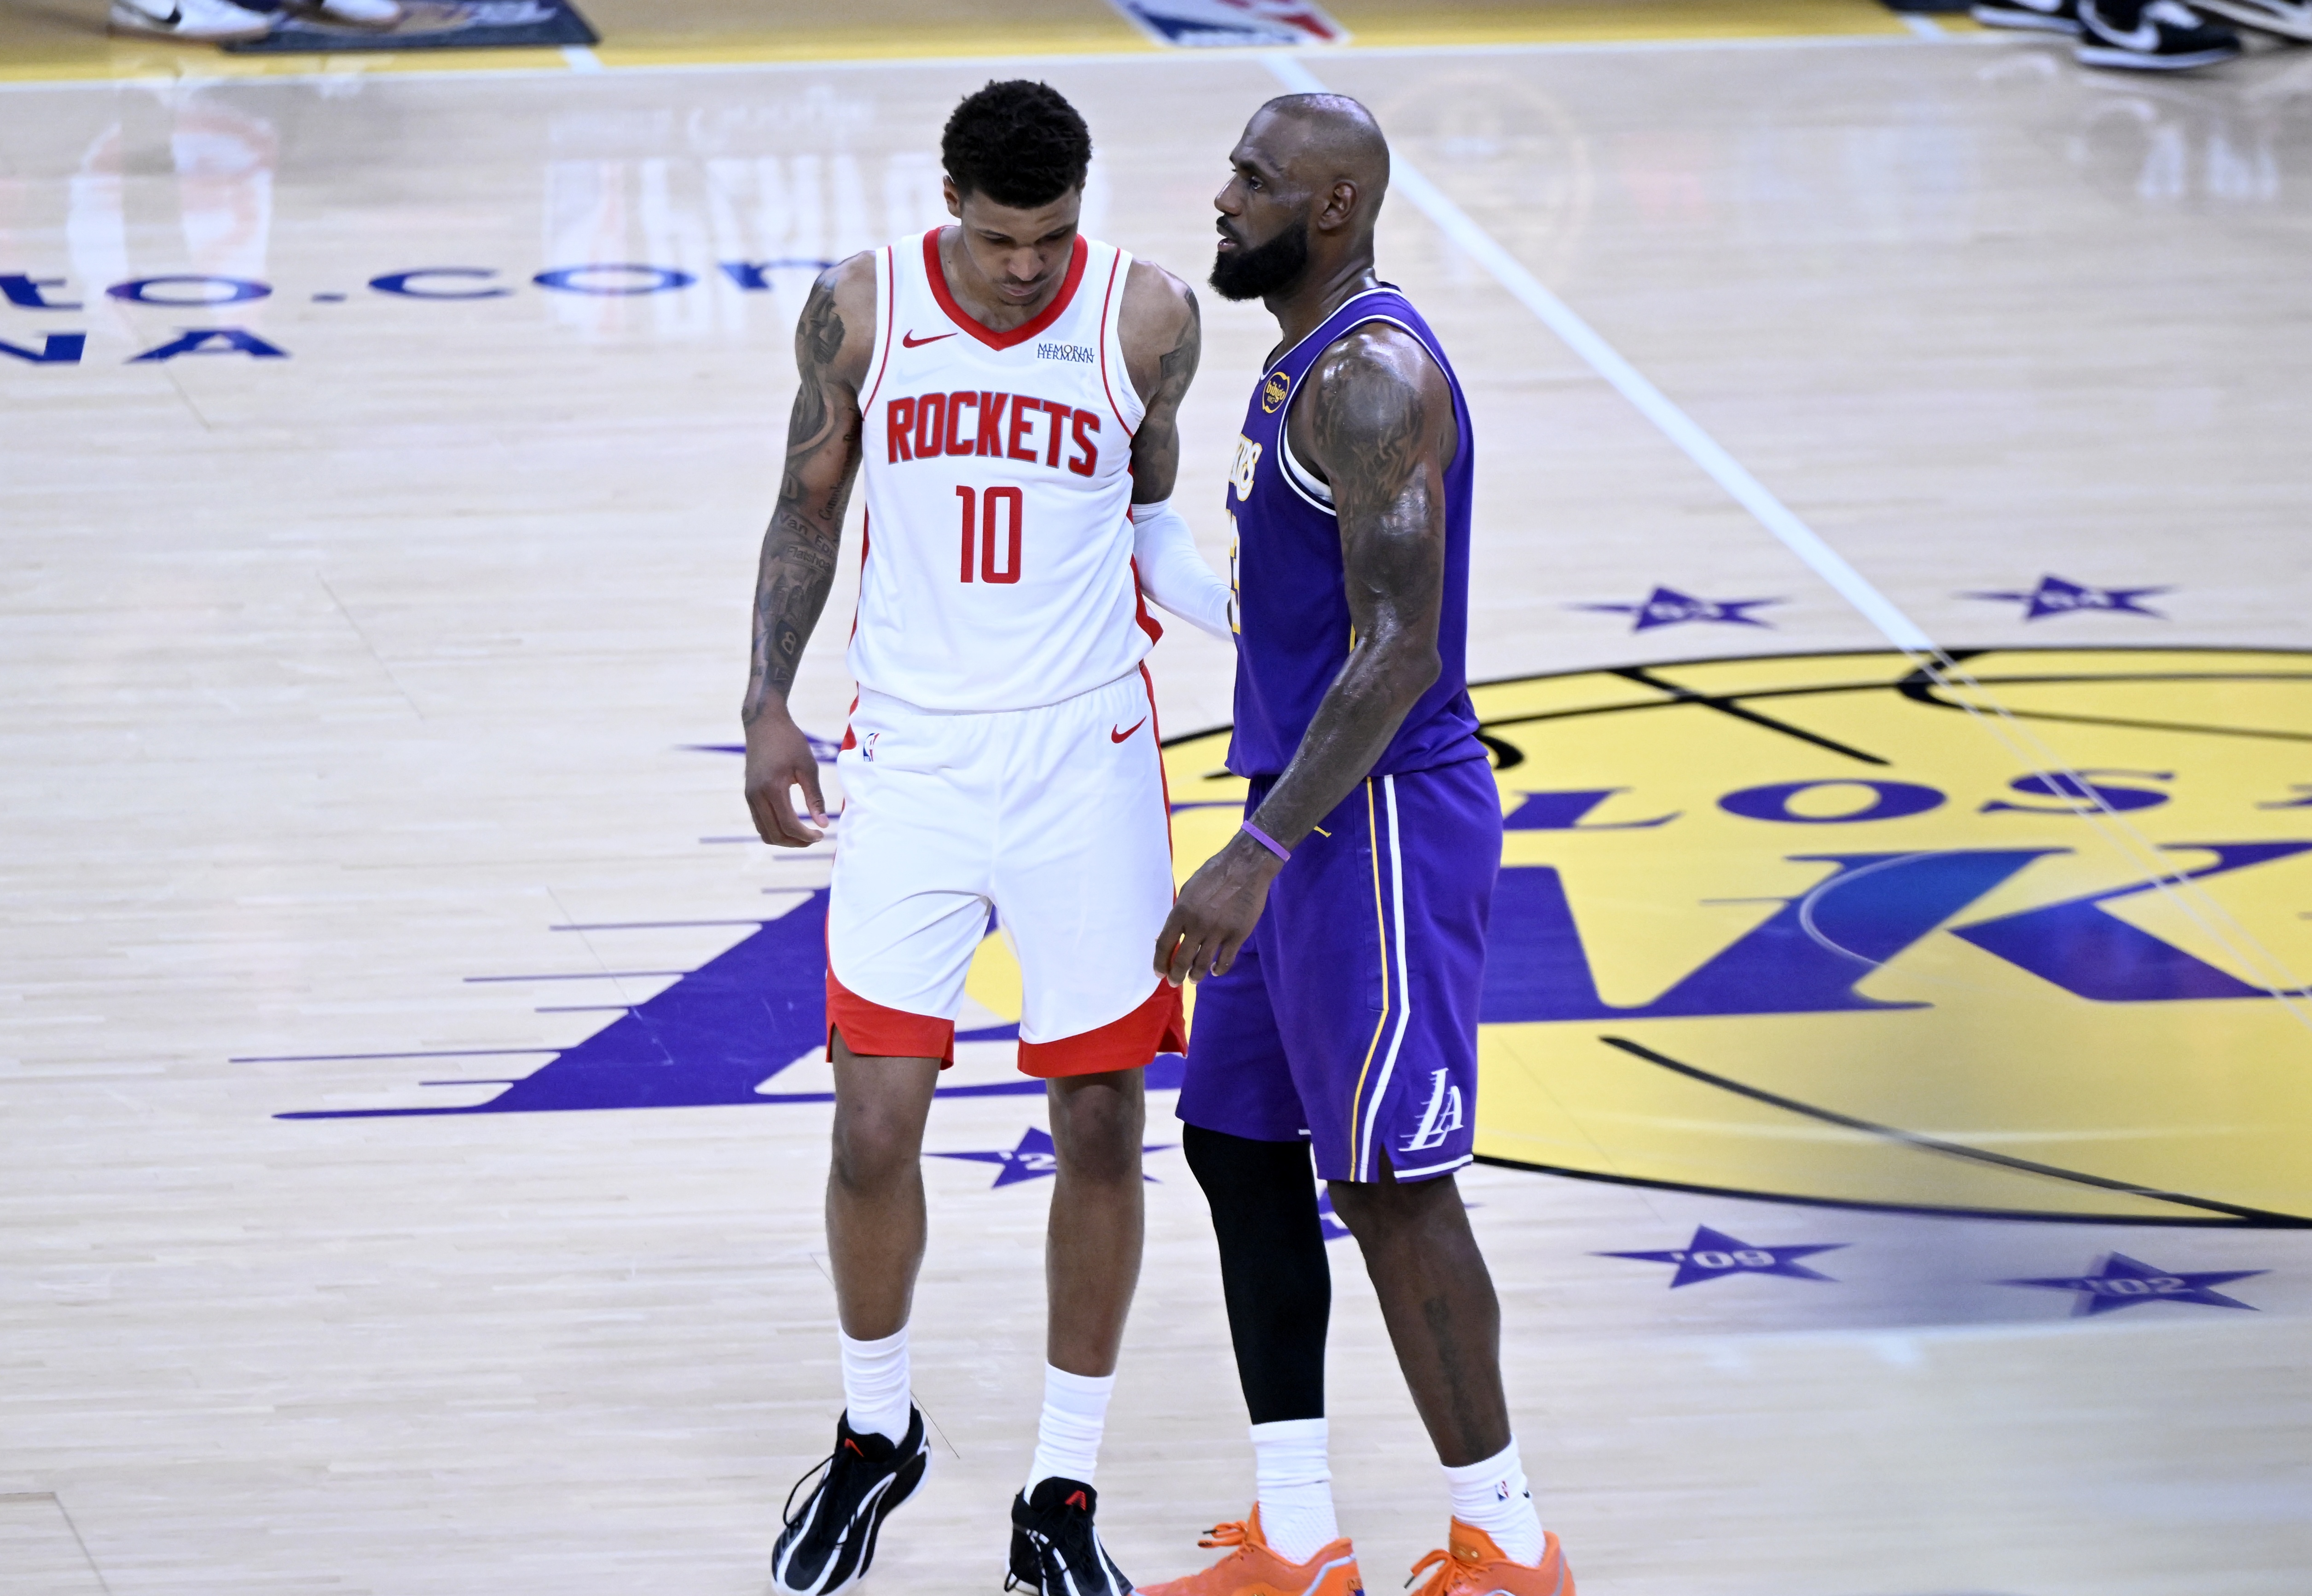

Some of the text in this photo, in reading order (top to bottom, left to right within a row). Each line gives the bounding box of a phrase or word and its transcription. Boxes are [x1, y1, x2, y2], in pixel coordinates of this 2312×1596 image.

[1037, 349, 1094, 364] HERMANN
[1038, 342, 1095, 357] MEMORIAL
[1266, 380, 1286, 403] bibigo
[887, 390, 1101, 478] ROCKETS
[956, 485, 1023, 584] 10
[1501, 769, 2176, 832] LOS
[1398, 1067, 1464, 1152] LA
